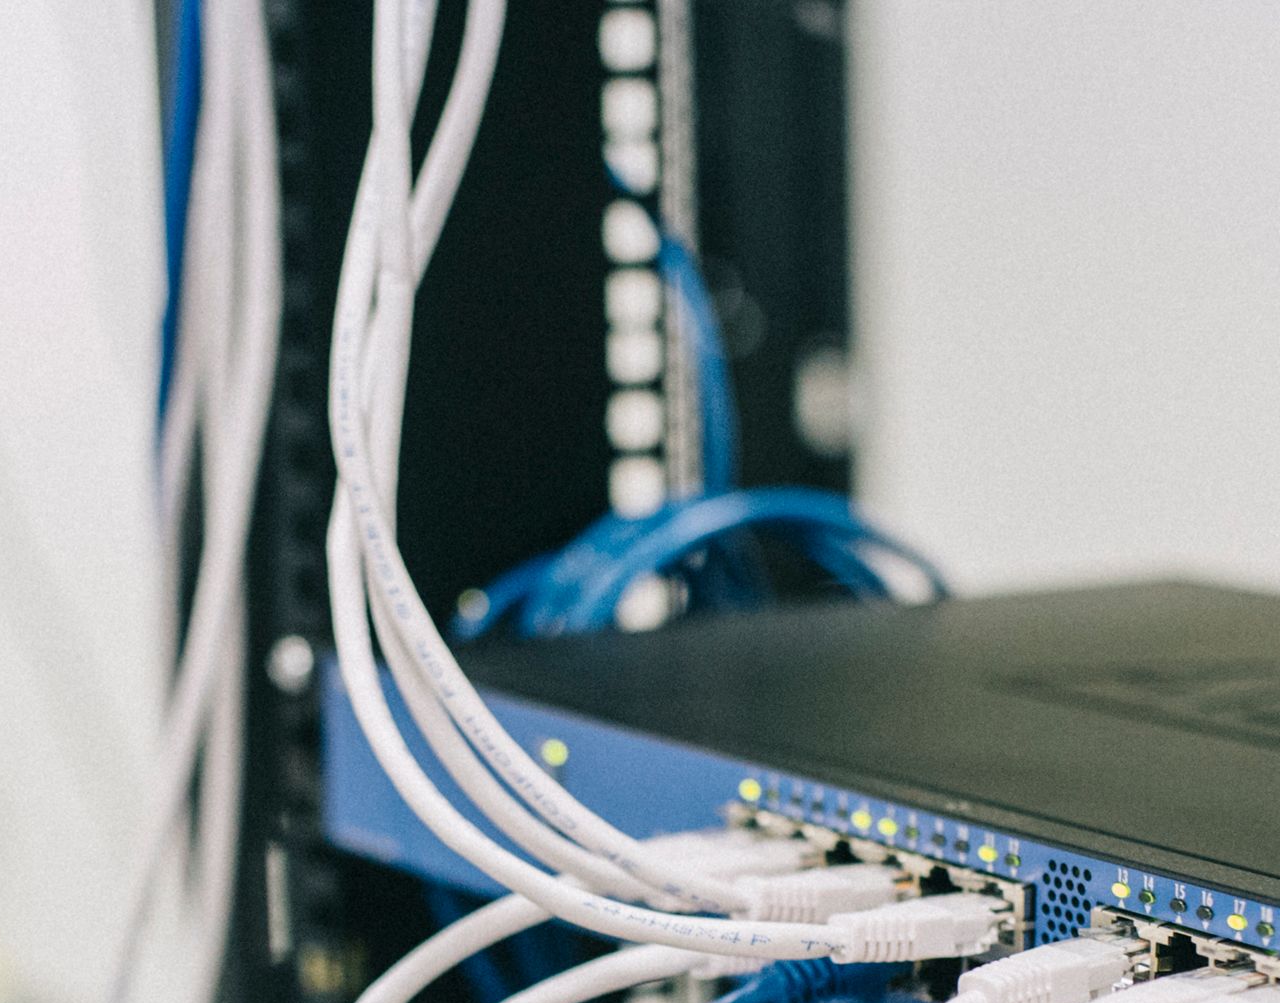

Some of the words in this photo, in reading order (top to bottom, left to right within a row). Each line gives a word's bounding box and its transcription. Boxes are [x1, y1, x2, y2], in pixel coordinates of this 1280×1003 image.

[1117, 867, 1129, 884] 13
[1143, 874, 1155, 890] 14
[1174, 883, 1186, 899] 15
[1201, 891, 1213, 907] 16
[1234, 899, 1246, 915] 17
